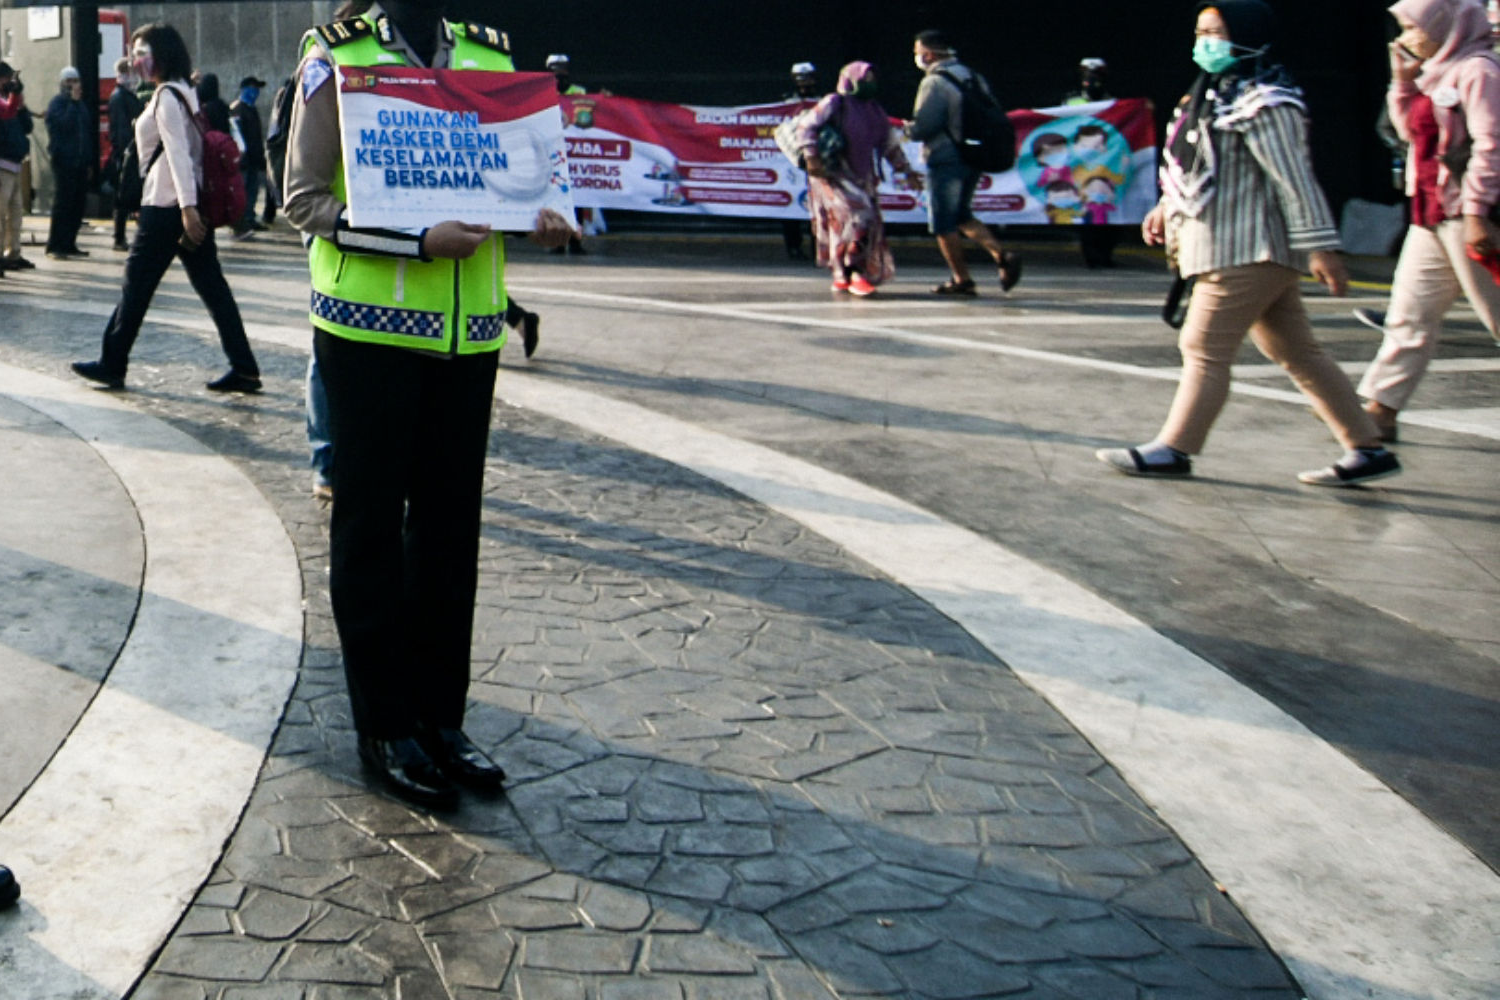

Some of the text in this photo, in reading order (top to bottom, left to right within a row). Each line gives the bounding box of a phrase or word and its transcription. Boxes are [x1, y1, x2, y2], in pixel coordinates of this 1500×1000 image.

[377, 109, 479, 129] GUNAKAN
[360, 128, 500, 150] MASKER DEMI
[355, 147, 509, 169] KESELAMATAN
[384, 168, 486, 189] BERSAMA
[579, 163, 622, 177] VIRUS
